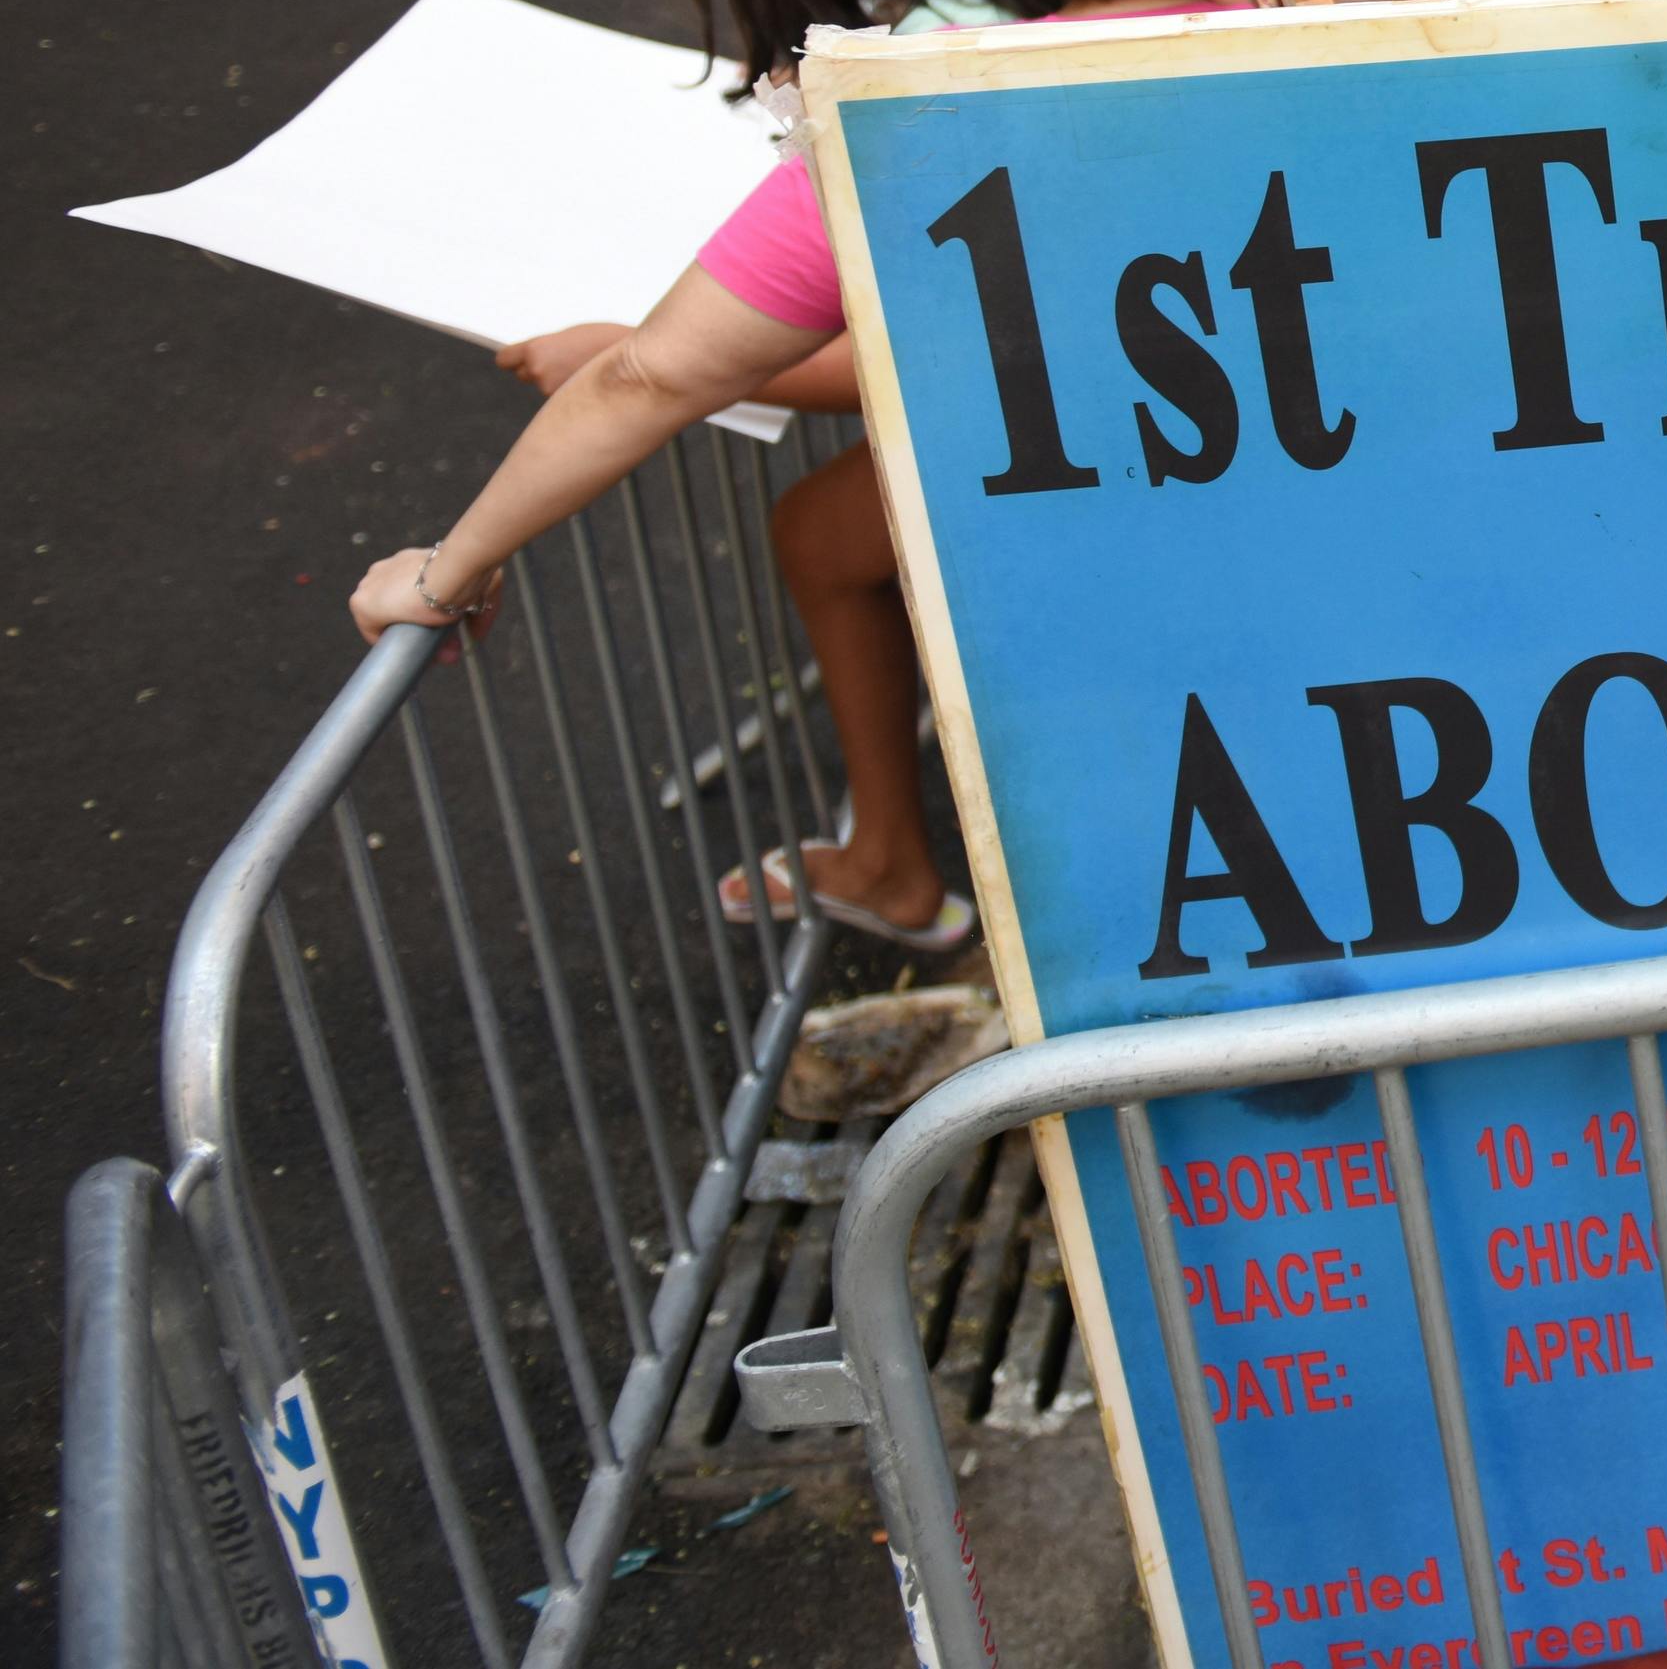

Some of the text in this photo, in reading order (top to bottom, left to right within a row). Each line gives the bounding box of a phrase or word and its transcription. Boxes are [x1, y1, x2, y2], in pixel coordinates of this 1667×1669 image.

[925, 163, 1358, 498] 1st
[1476, 1124, 1534, 1191] 10
[1551, 1152, 1568, 1167] -
[1583, 1110, 1642, 1178] 12
[1504, 1311, 1654, 1388] APRIL
[1247, 1557, 1444, 1628] Buried
[1499, 1547, 1526, 1595] t
[1542, 1535, 1627, 1588] St.
[1328, 1613, 1644, 1669] Everreen
